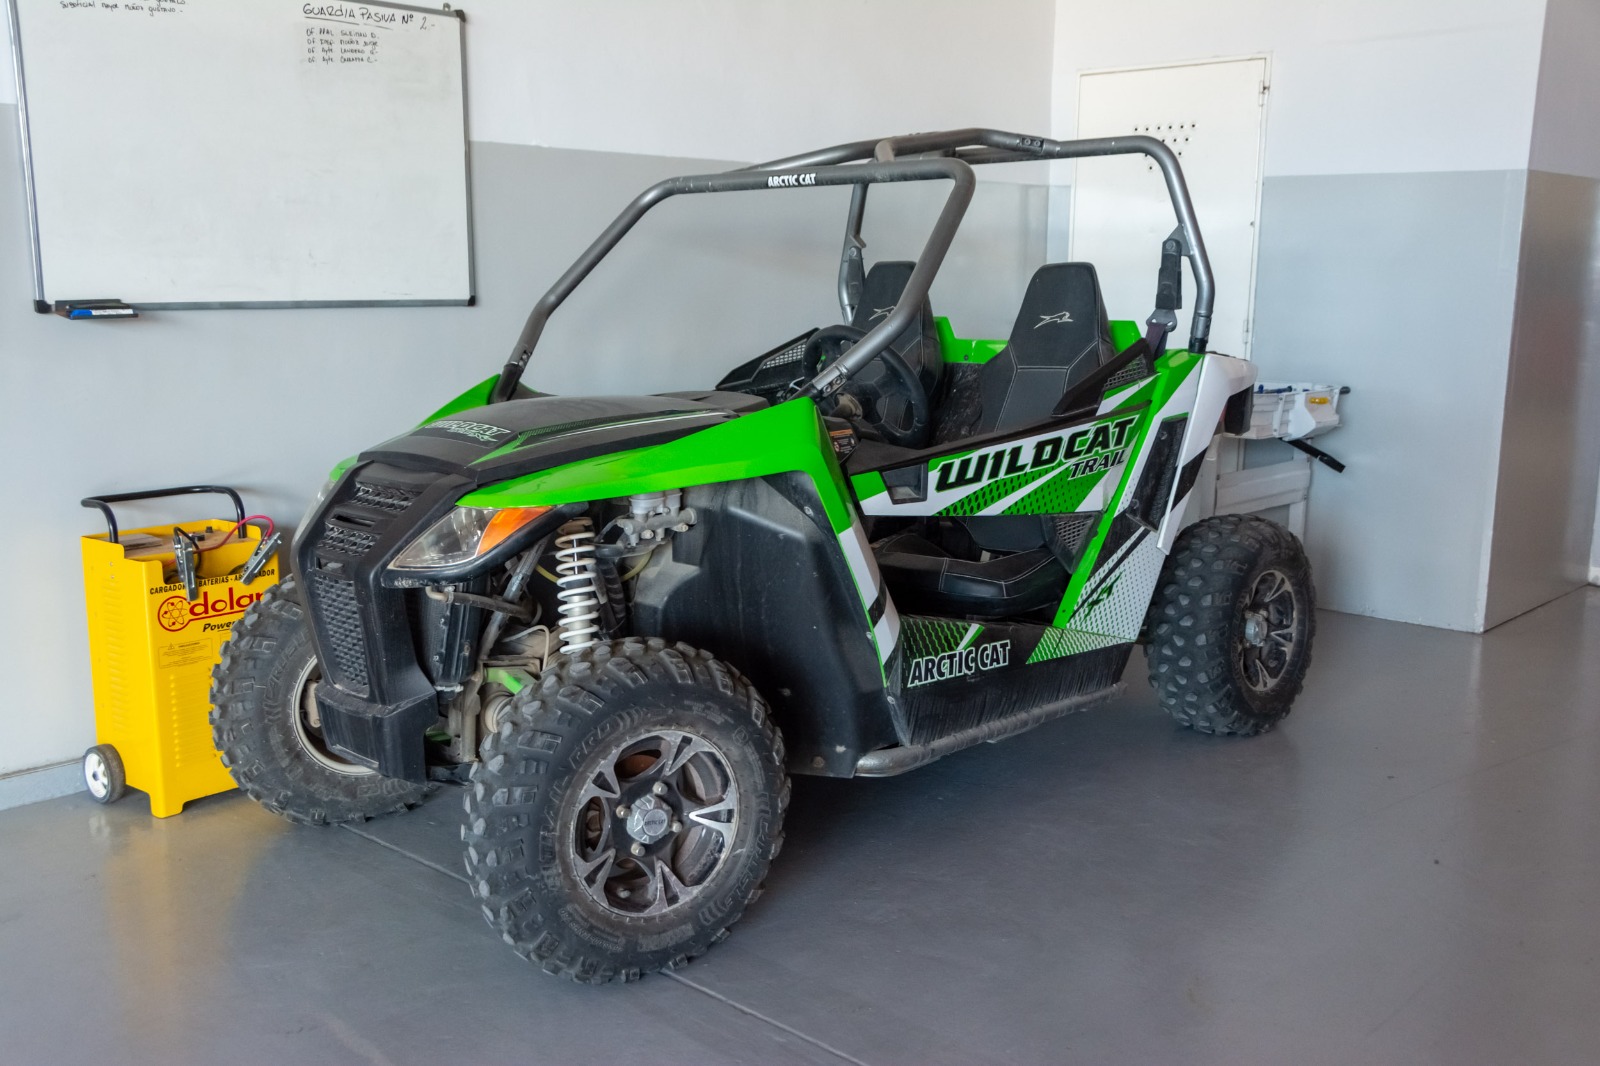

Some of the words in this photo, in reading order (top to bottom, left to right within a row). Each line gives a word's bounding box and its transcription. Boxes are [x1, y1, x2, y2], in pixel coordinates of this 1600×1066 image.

[359, 7, 396, 23] PASIVA
[768, 175, 798, 188] ARCTIC
[799, 173, 816, 185] CAT
[934, 414, 1140, 493] WILDCAT
[1068, 449, 1127, 481] TRAIL
[198, 576, 229, 588] BATERIAS
[907, 646, 976, 688] ARCTIC
[978, 639, 1011, 671] CAT
